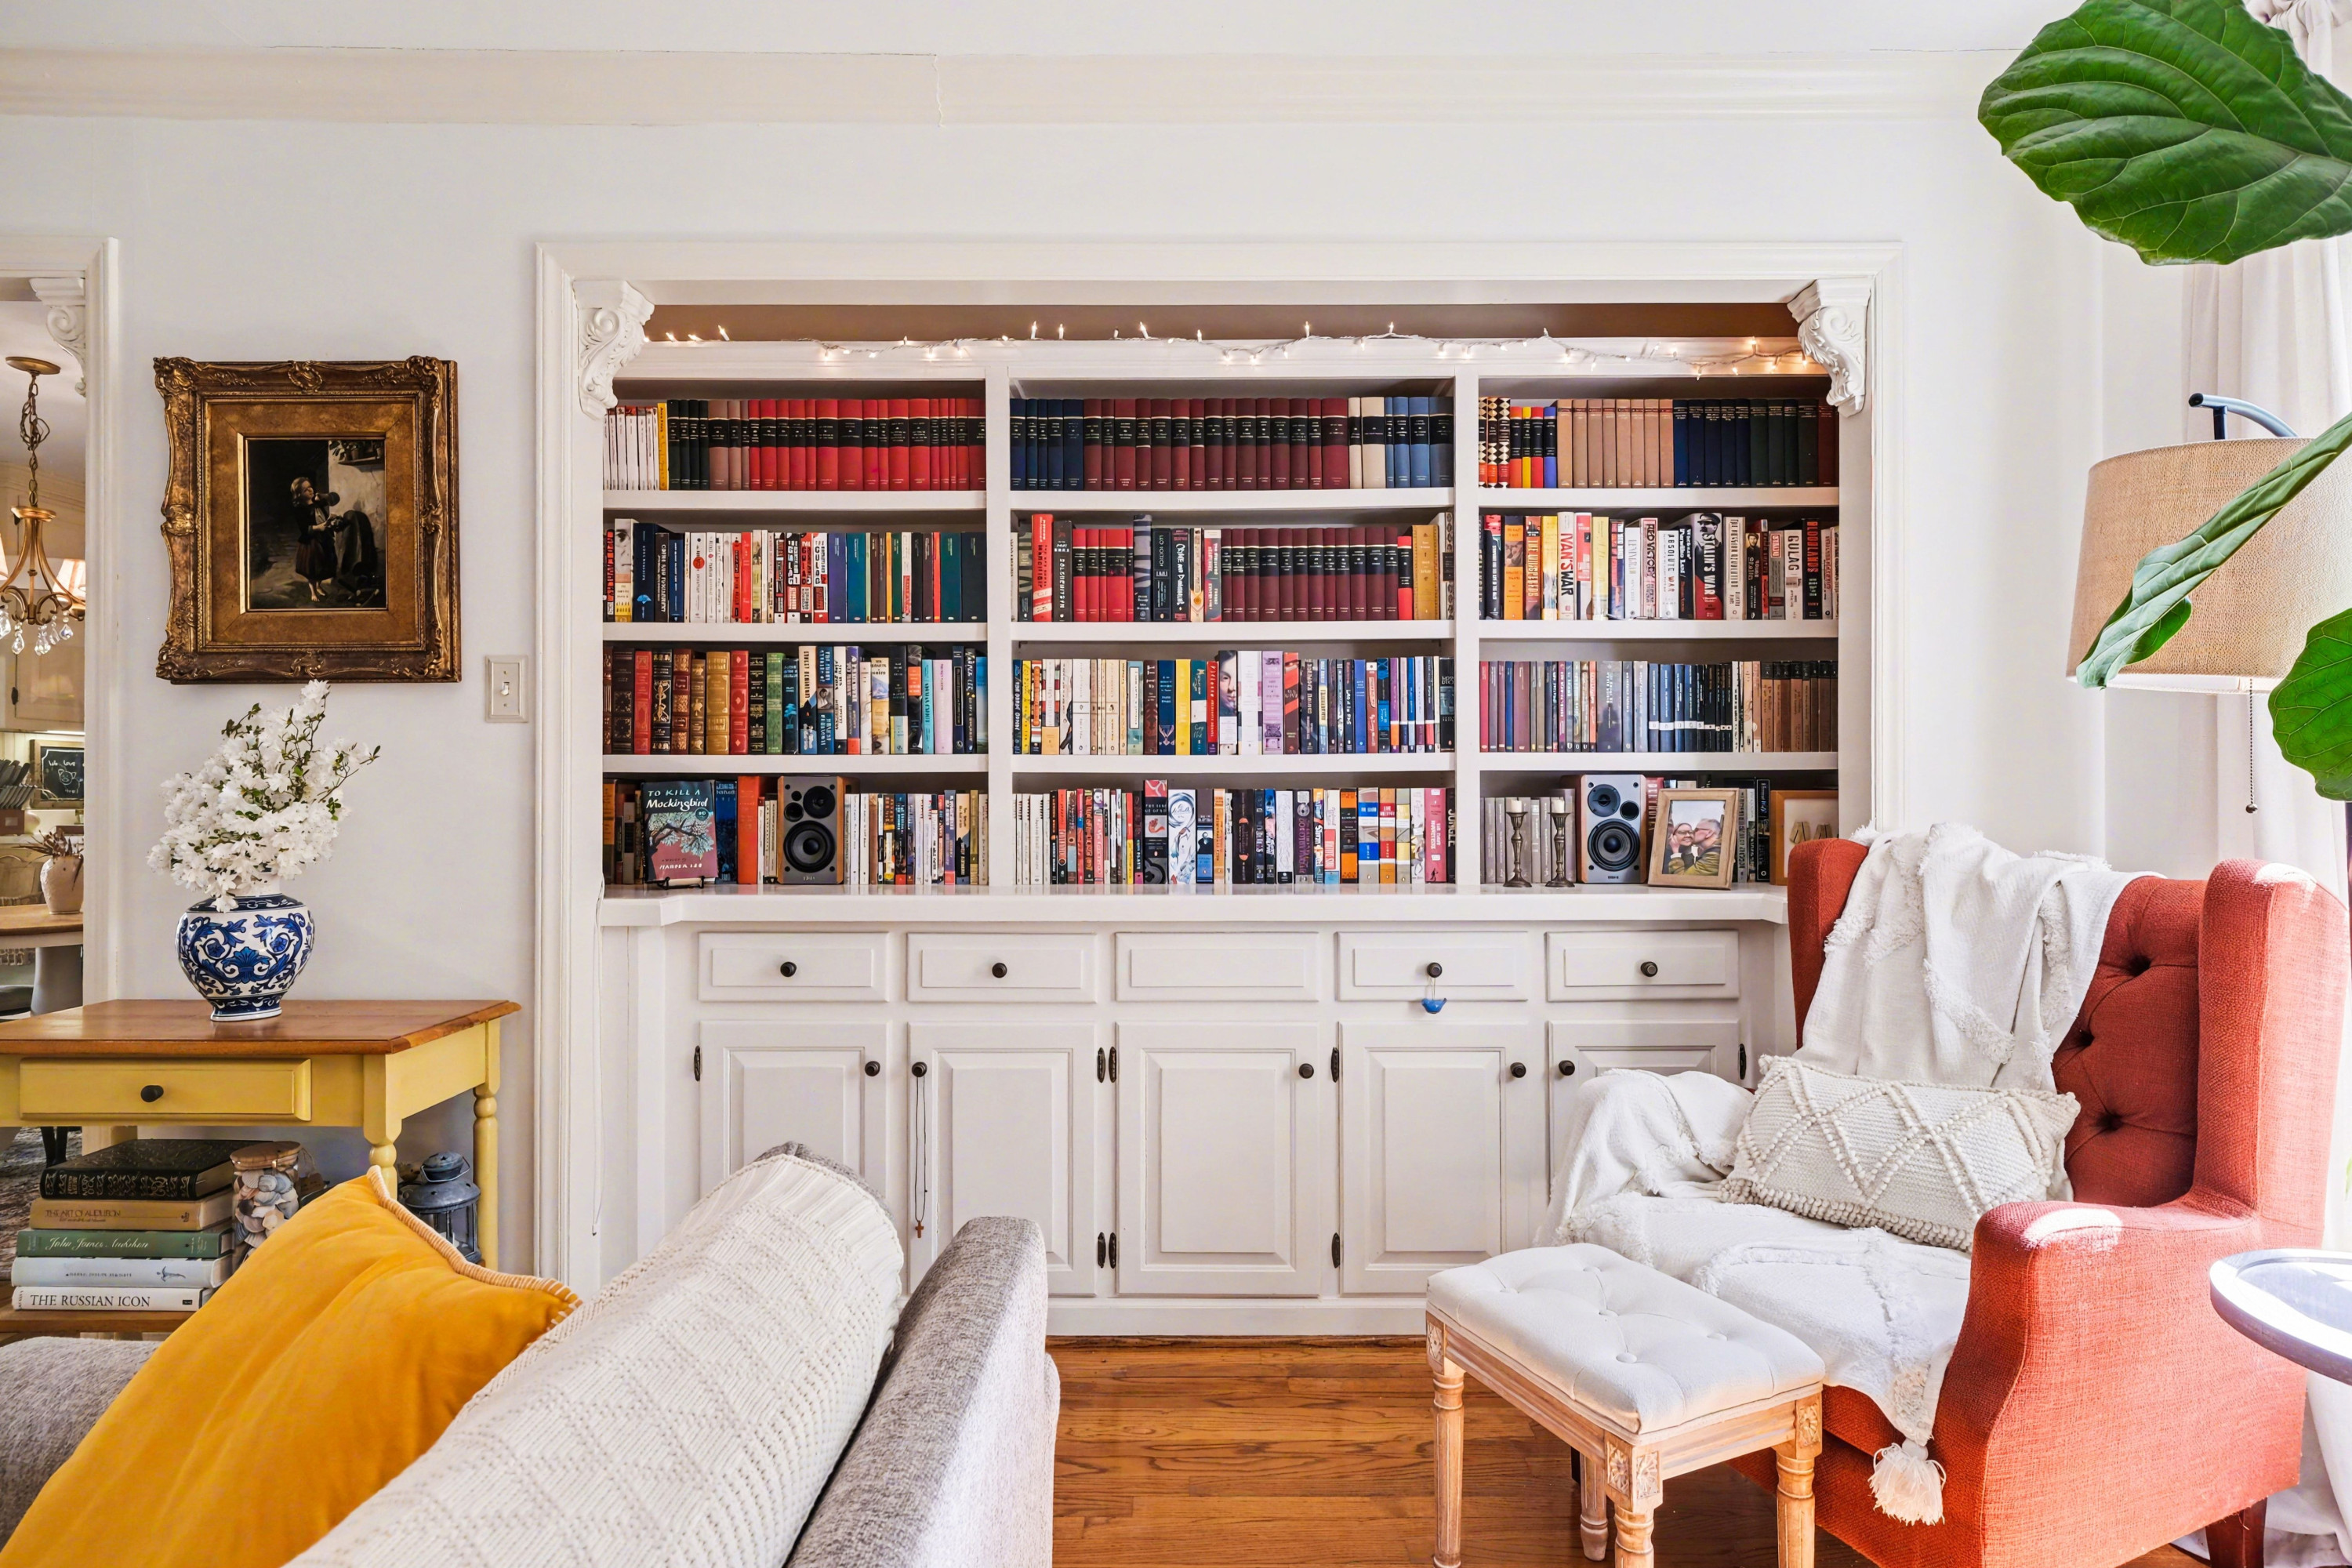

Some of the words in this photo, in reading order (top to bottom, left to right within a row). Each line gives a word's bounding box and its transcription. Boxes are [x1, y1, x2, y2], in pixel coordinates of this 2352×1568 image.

[1646, 524, 1655, 541] RED
[1561, 533, 1573, 570] IVAN'S
[1704, 534, 1715, 572] STALIN'S
[1788, 535, 1799, 571] GULAG
[1806, 521, 1818, 572] BLOODLANDS
[1561, 571, 1573, 596] WAR
[1704, 575, 1715, 595] WAR
[646, 797, 709, 811] Mockingbird
[45, 1237, 71, 1250] John
[30, 1295, 56, 1306] THE
[61, 1295, 114, 1306] RUSSIAN
[118, 1295, 151, 1307] ICON
